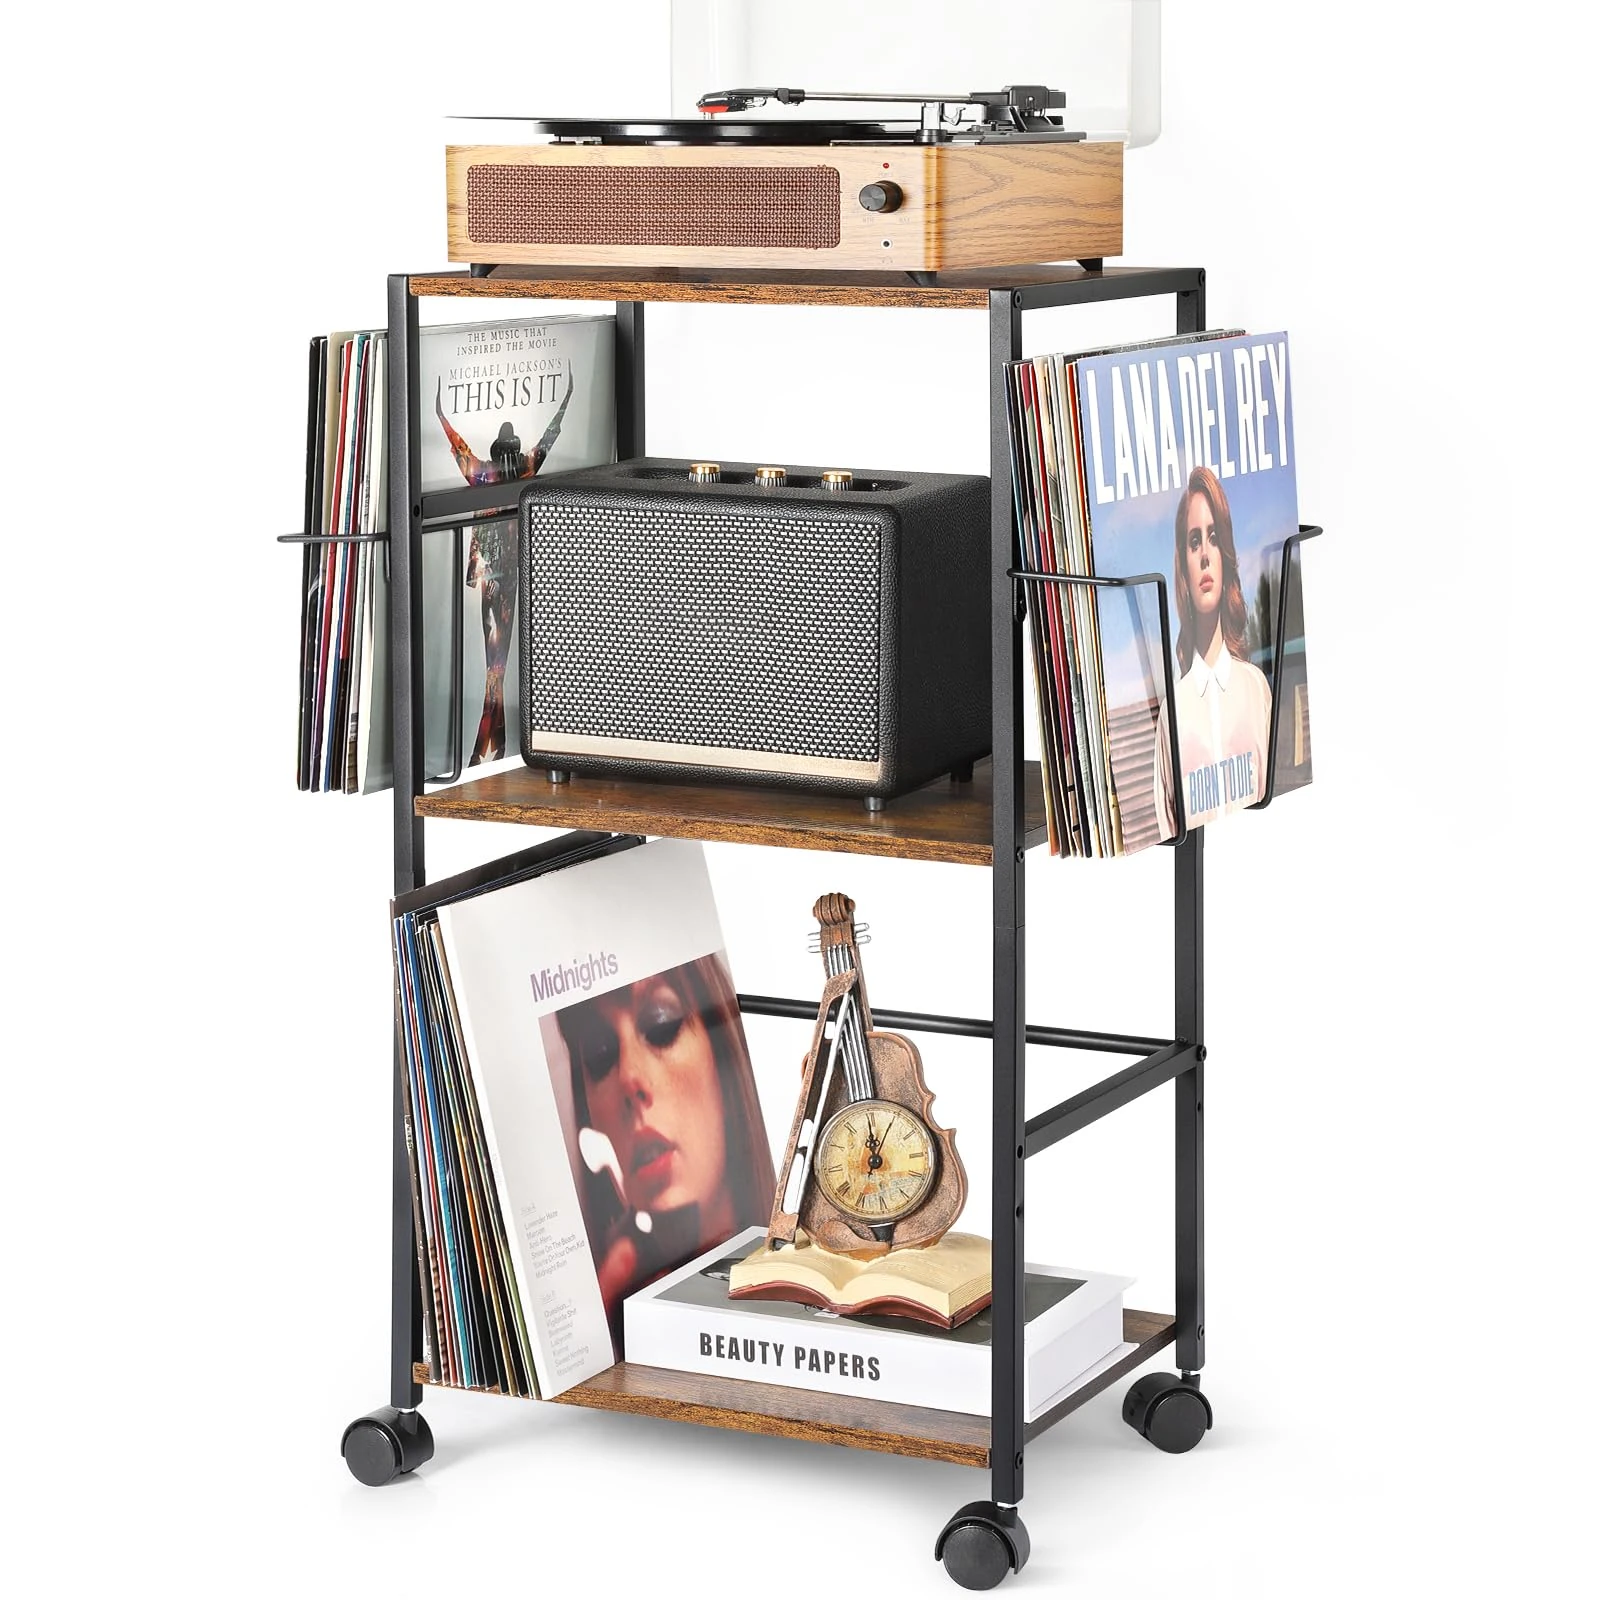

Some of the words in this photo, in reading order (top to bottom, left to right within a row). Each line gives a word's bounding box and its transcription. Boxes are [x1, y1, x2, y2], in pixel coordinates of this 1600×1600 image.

[457, 343, 501, 356] INSPIRED
[506, 341, 524, 352] THE
[528, 338, 557, 350] MOVIE
[468, 332, 486, 342] THE
[491, 329, 520, 340] MUSIC
[524, 327, 547, 338] THAT
[449, 364, 501, 380] MICHAEL
[506, 358, 563, 376] JACKSON'S
[448, 379, 505, 415] THIS
[511, 376, 531, 407] IS
[538, 373, 563, 404] IT
[1086, 359, 1181, 504] LANA
[1177, 351, 1236, 487] DEL
[1233, 342, 1288, 475] REY
[1189, 763, 1220, 816] BORN
[1219, 757, 1237, 804] TO
[1236, 752, 1254, 799] DIE
[530, 951, 618, 1003] Midnights
[561, 1234, 577, 1245] Beach
[700, 1332, 784, 1367] BEAUTY
[794, 1346, 881, 1382] PAPERS
